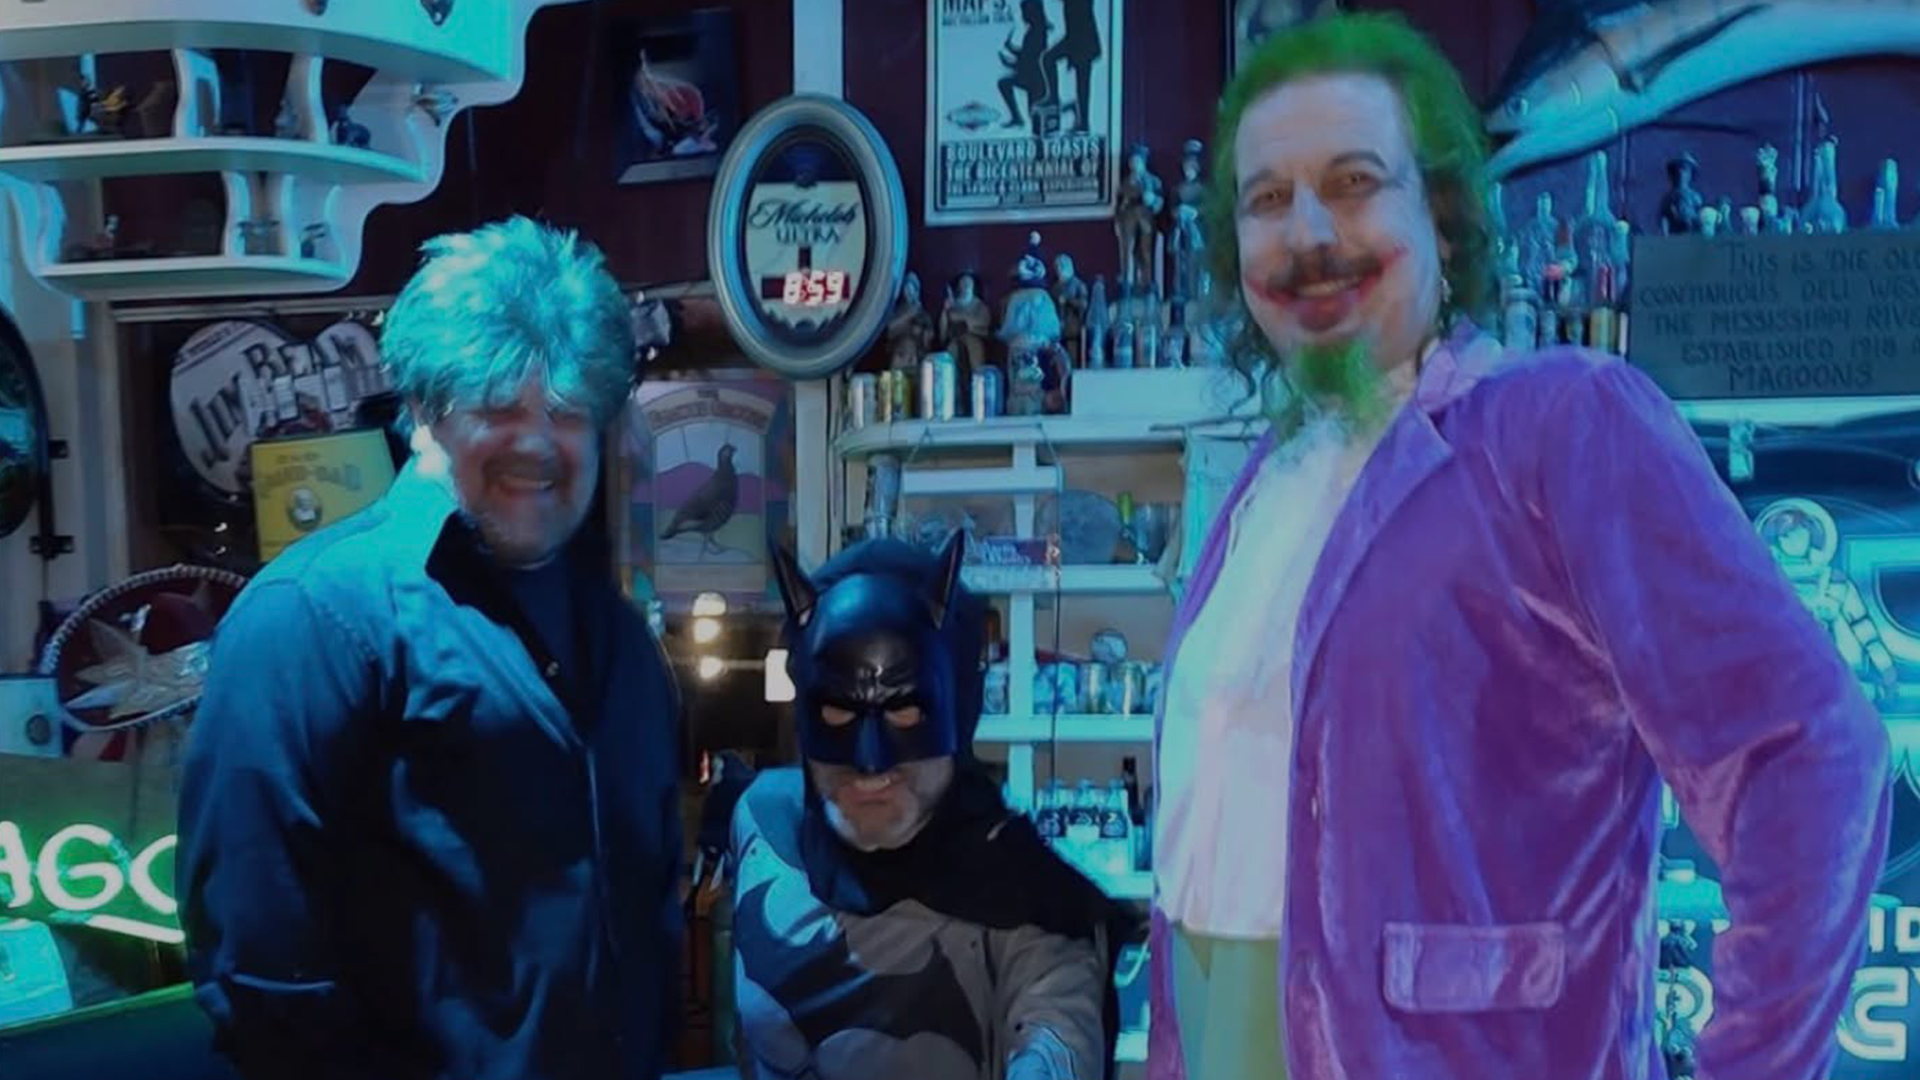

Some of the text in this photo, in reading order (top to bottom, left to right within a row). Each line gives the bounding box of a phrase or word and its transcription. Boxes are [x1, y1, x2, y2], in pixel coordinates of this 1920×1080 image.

[947, 136, 1099, 161] BOULEVARD TOASTS
[750, 201, 859, 229] Michelob
[776, 225, 840, 244] ULTRA
[783, 270, 845, 305] 8:59
[1730, 360, 1874, 392] MAGOONS
